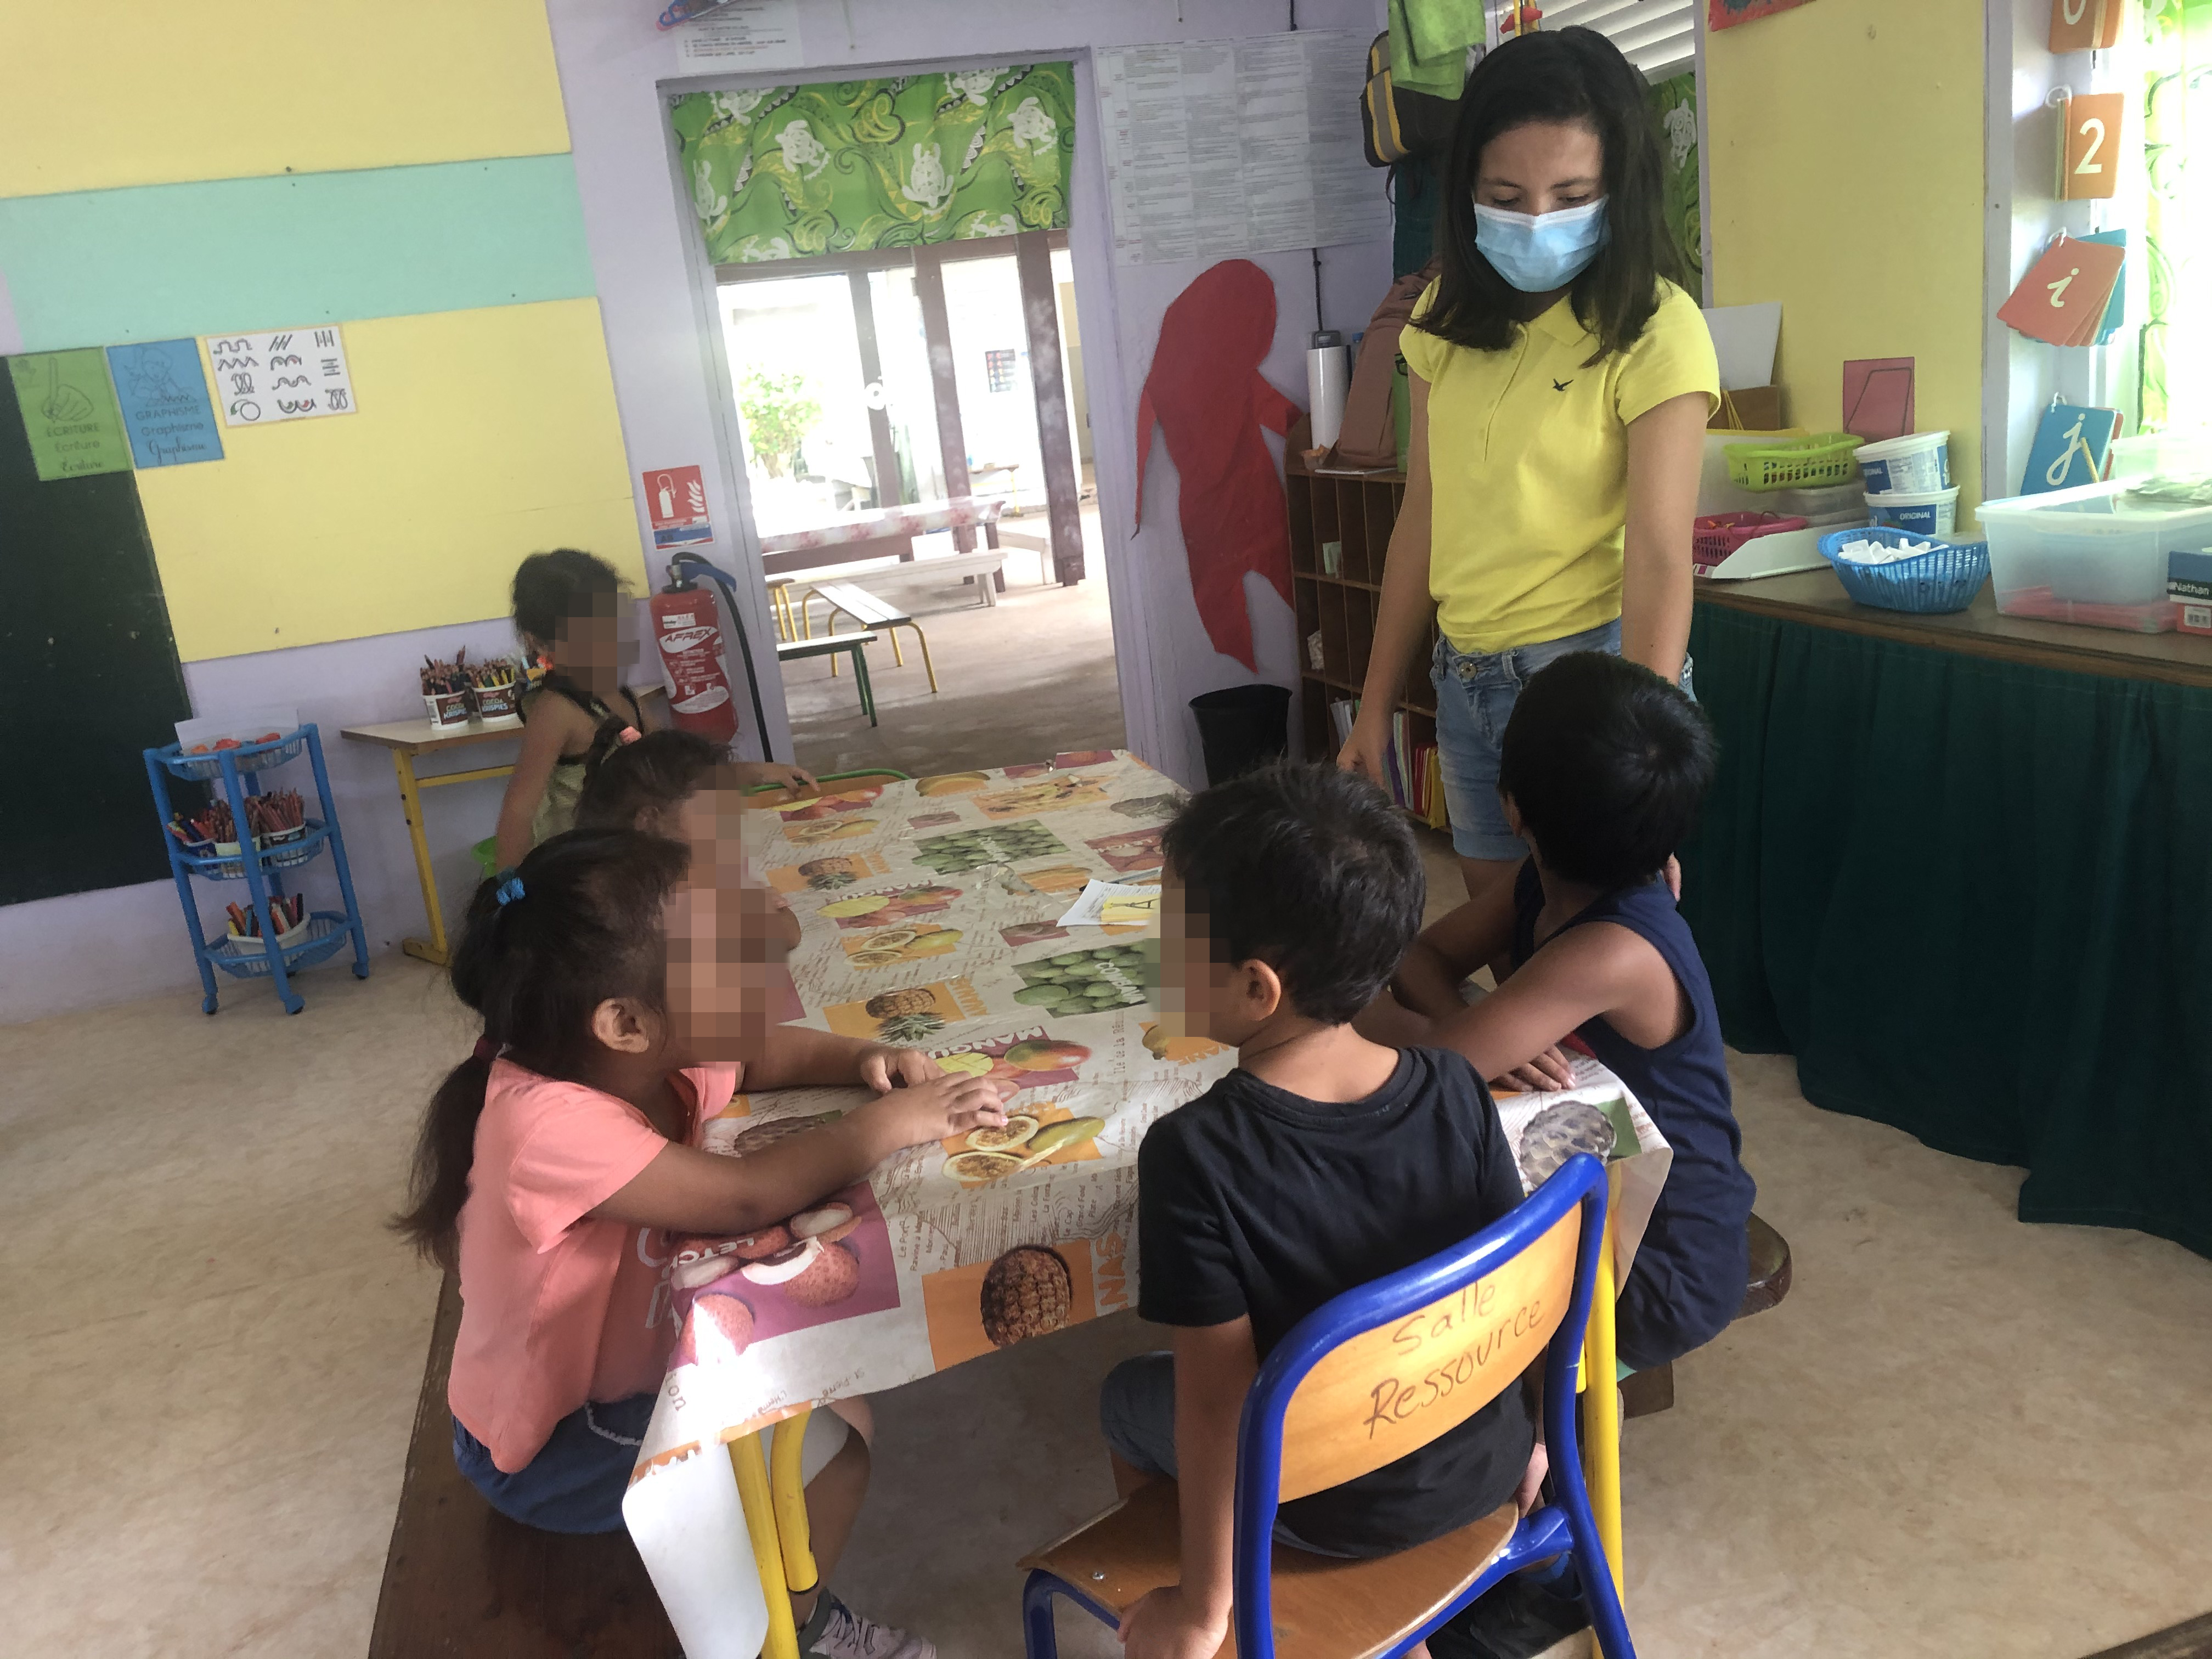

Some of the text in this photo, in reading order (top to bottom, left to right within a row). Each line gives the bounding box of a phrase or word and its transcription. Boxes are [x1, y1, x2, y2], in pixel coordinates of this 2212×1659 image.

[2074, 118, 2106, 174] 2
[2047, 268, 2080, 308] i
[2046, 414, 2086, 486] j
[1899, 511, 1931, 521] ORIGINAL
[2177, 582, 2210, 596] Nathan
[1392, 1280, 1496, 1356] Salle
[1363, 1300, 1544, 1440] Ressource
